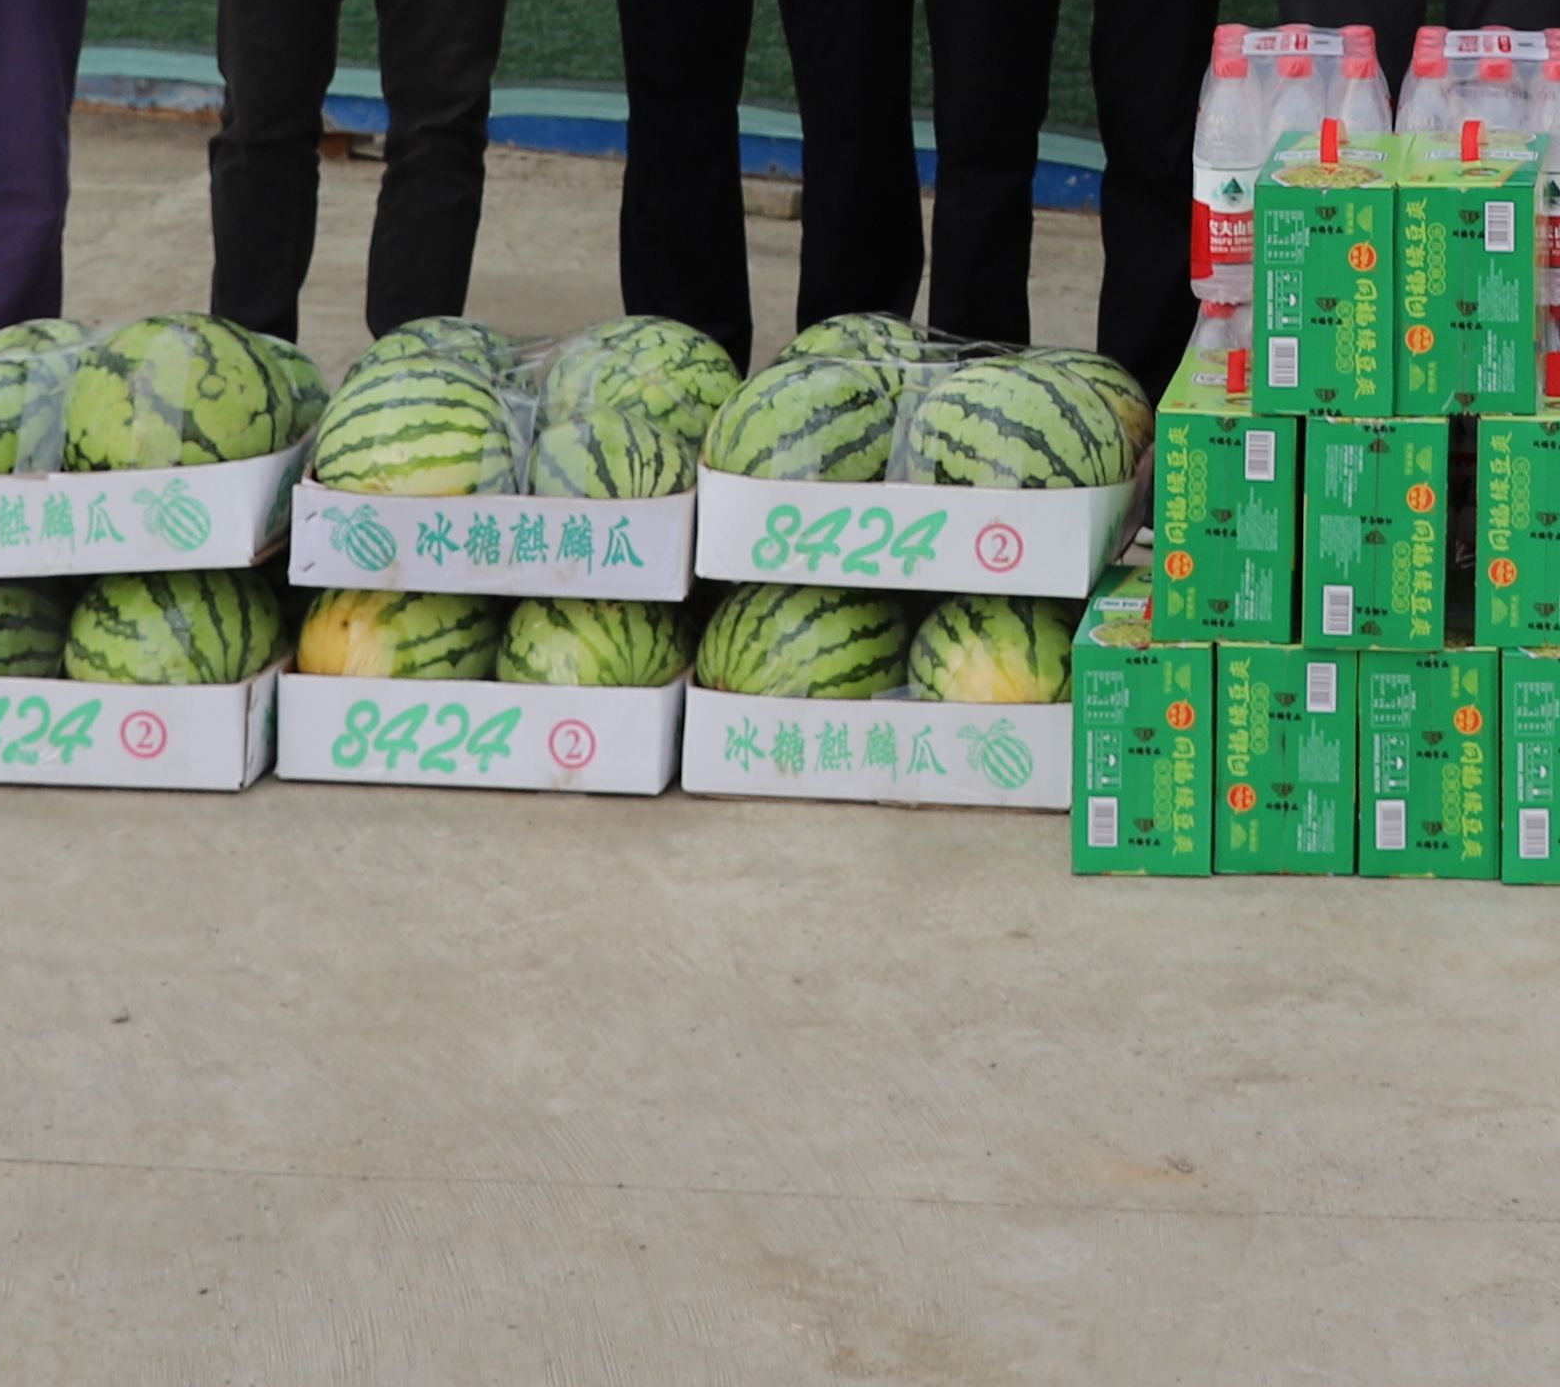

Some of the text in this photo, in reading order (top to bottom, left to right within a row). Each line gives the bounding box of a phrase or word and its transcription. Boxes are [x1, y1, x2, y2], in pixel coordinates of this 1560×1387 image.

[415, 509, 645, 574] 冰糖麒麟瓜
[750, 503, 948, 575] 8424
[330, 698, 522, 774] 8424
[723, 716, 947, 785] 冰糖麒麟瓜
